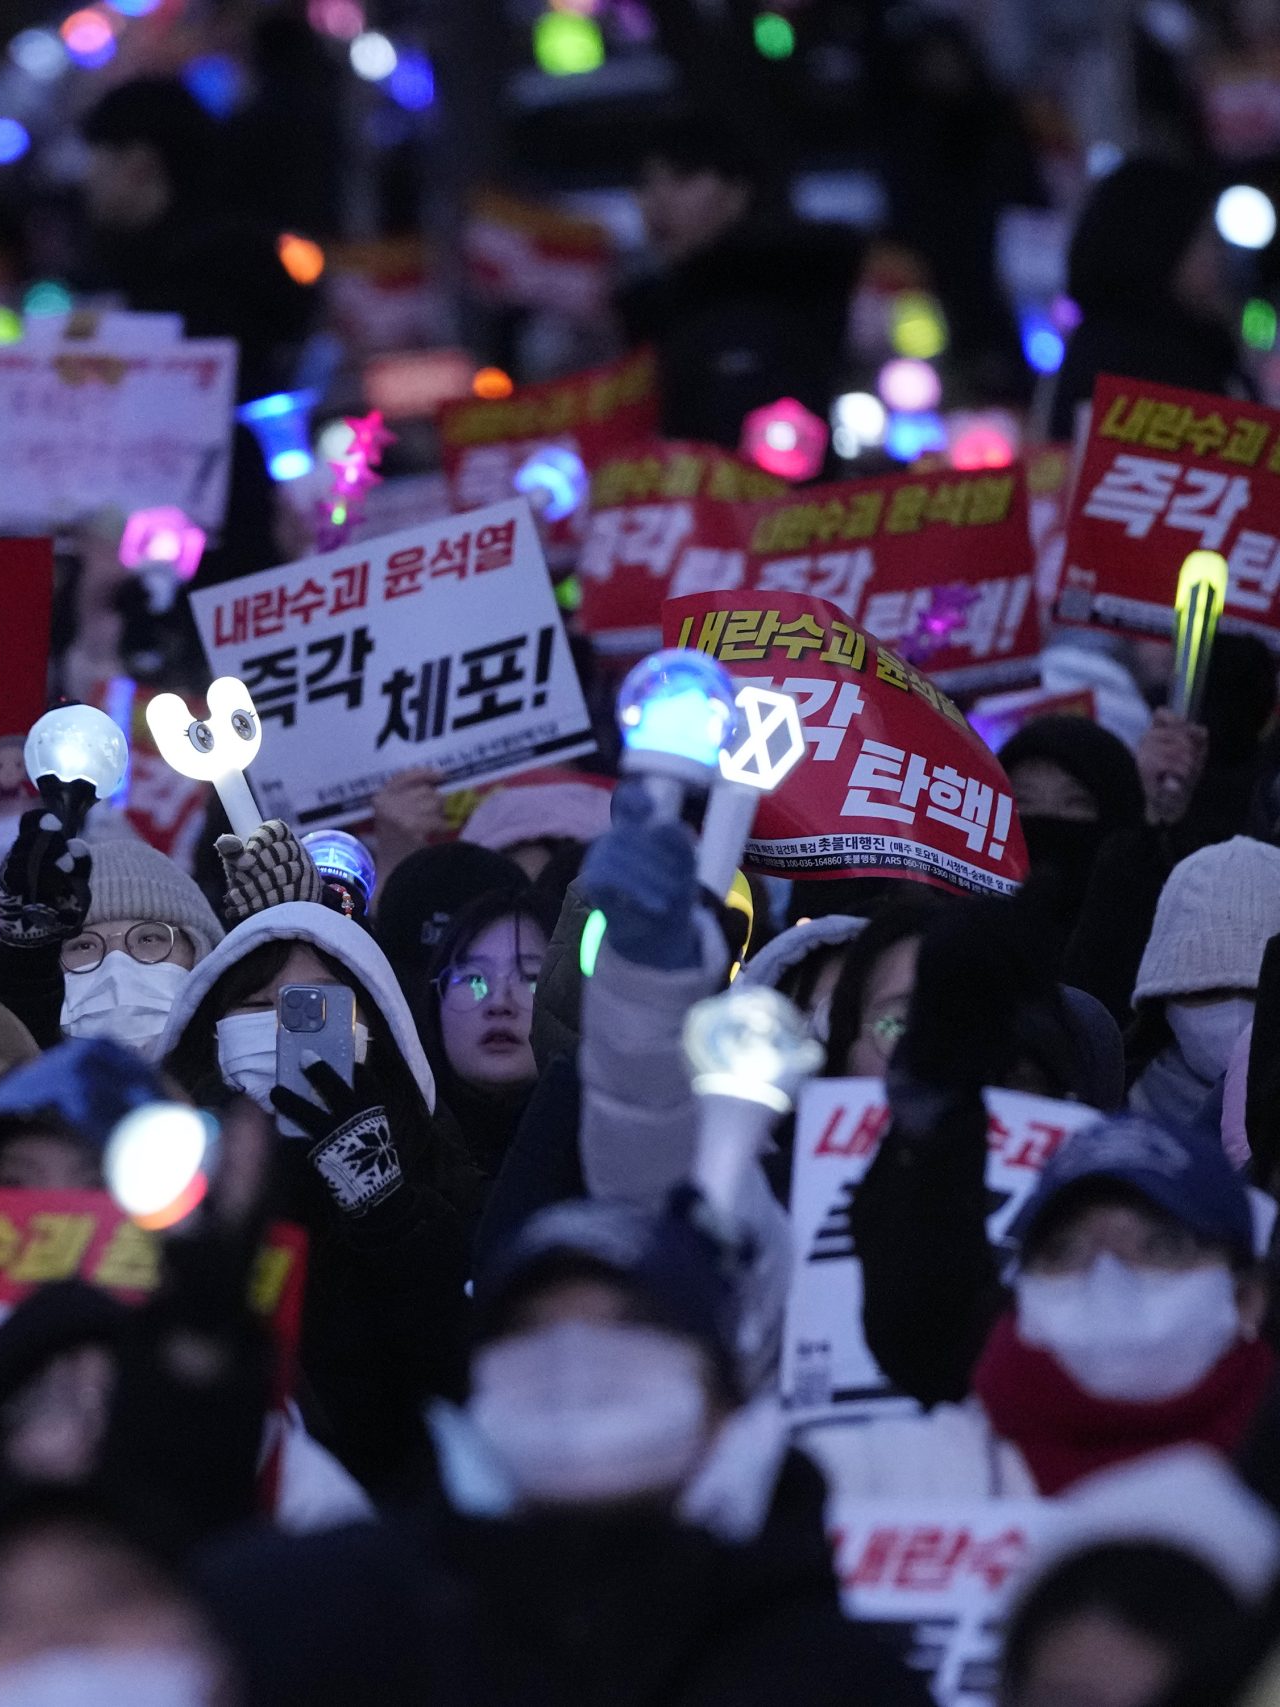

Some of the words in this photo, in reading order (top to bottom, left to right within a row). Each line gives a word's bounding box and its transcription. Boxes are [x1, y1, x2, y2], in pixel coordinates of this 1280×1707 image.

[1098, 394, 1271, 467] 내란수괴
[1083, 453, 1252, 550] 즉각
[214, 560, 369, 649] 내란수괴
[382, 517, 517, 601] 윤석열
[240, 627, 374, 730] 즉각
[376, 624, 557, 750] 체포!
[676, 609, 866, 672] 내란수괴
[839, 738, 1014, 861] 탄핵!
[775, 844, 799, 856] 김건희
[800, 842, 817, 854] 특검
[818, 835, 886, 853] 촛불대행진
[889, 840, 913, 855] (매주
[914, 845, 939, 864] 토요일
[787, 855, 842, 868] 100-036-164860
[843, 853, 879, 865] 촛불행동
[884, 856, 902, 866] ARS
